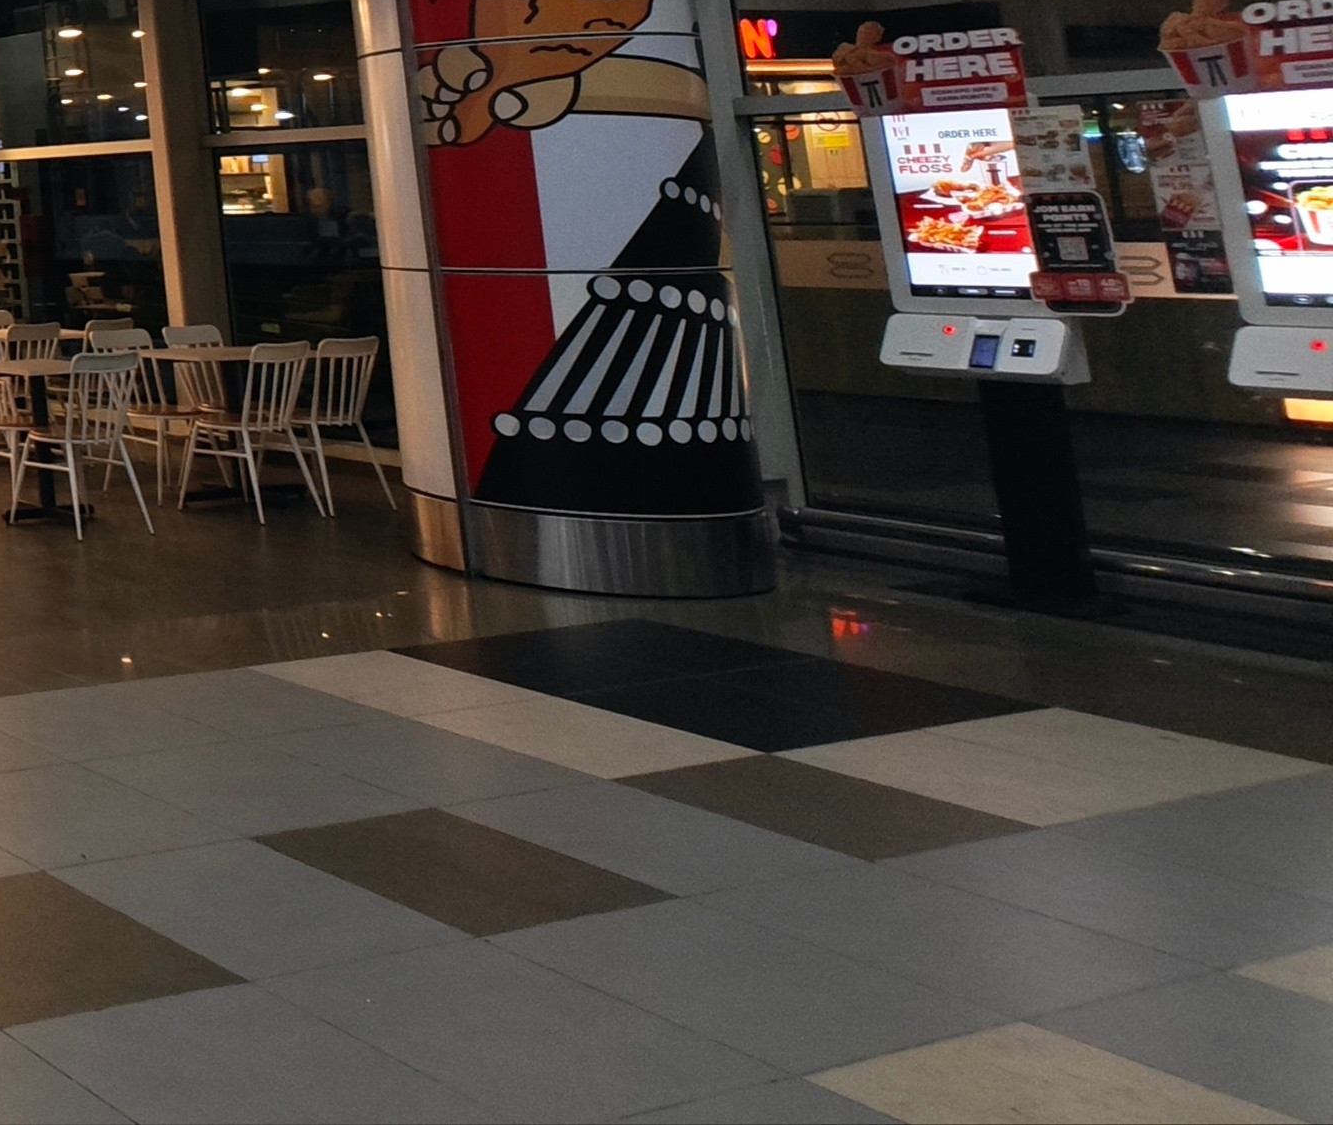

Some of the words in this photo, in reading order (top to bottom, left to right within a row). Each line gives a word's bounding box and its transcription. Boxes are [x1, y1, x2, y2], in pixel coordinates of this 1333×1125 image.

[893, 27, 1024, 55] ORDER
[905, 52, 1018, 82] HERE
[938, 130, 971, 139] ORDER
[973, 128, 998, 138] HERE
[897, 155, 951, 164] CHEEZY
[899, 164, 953, 174] FLOSS
